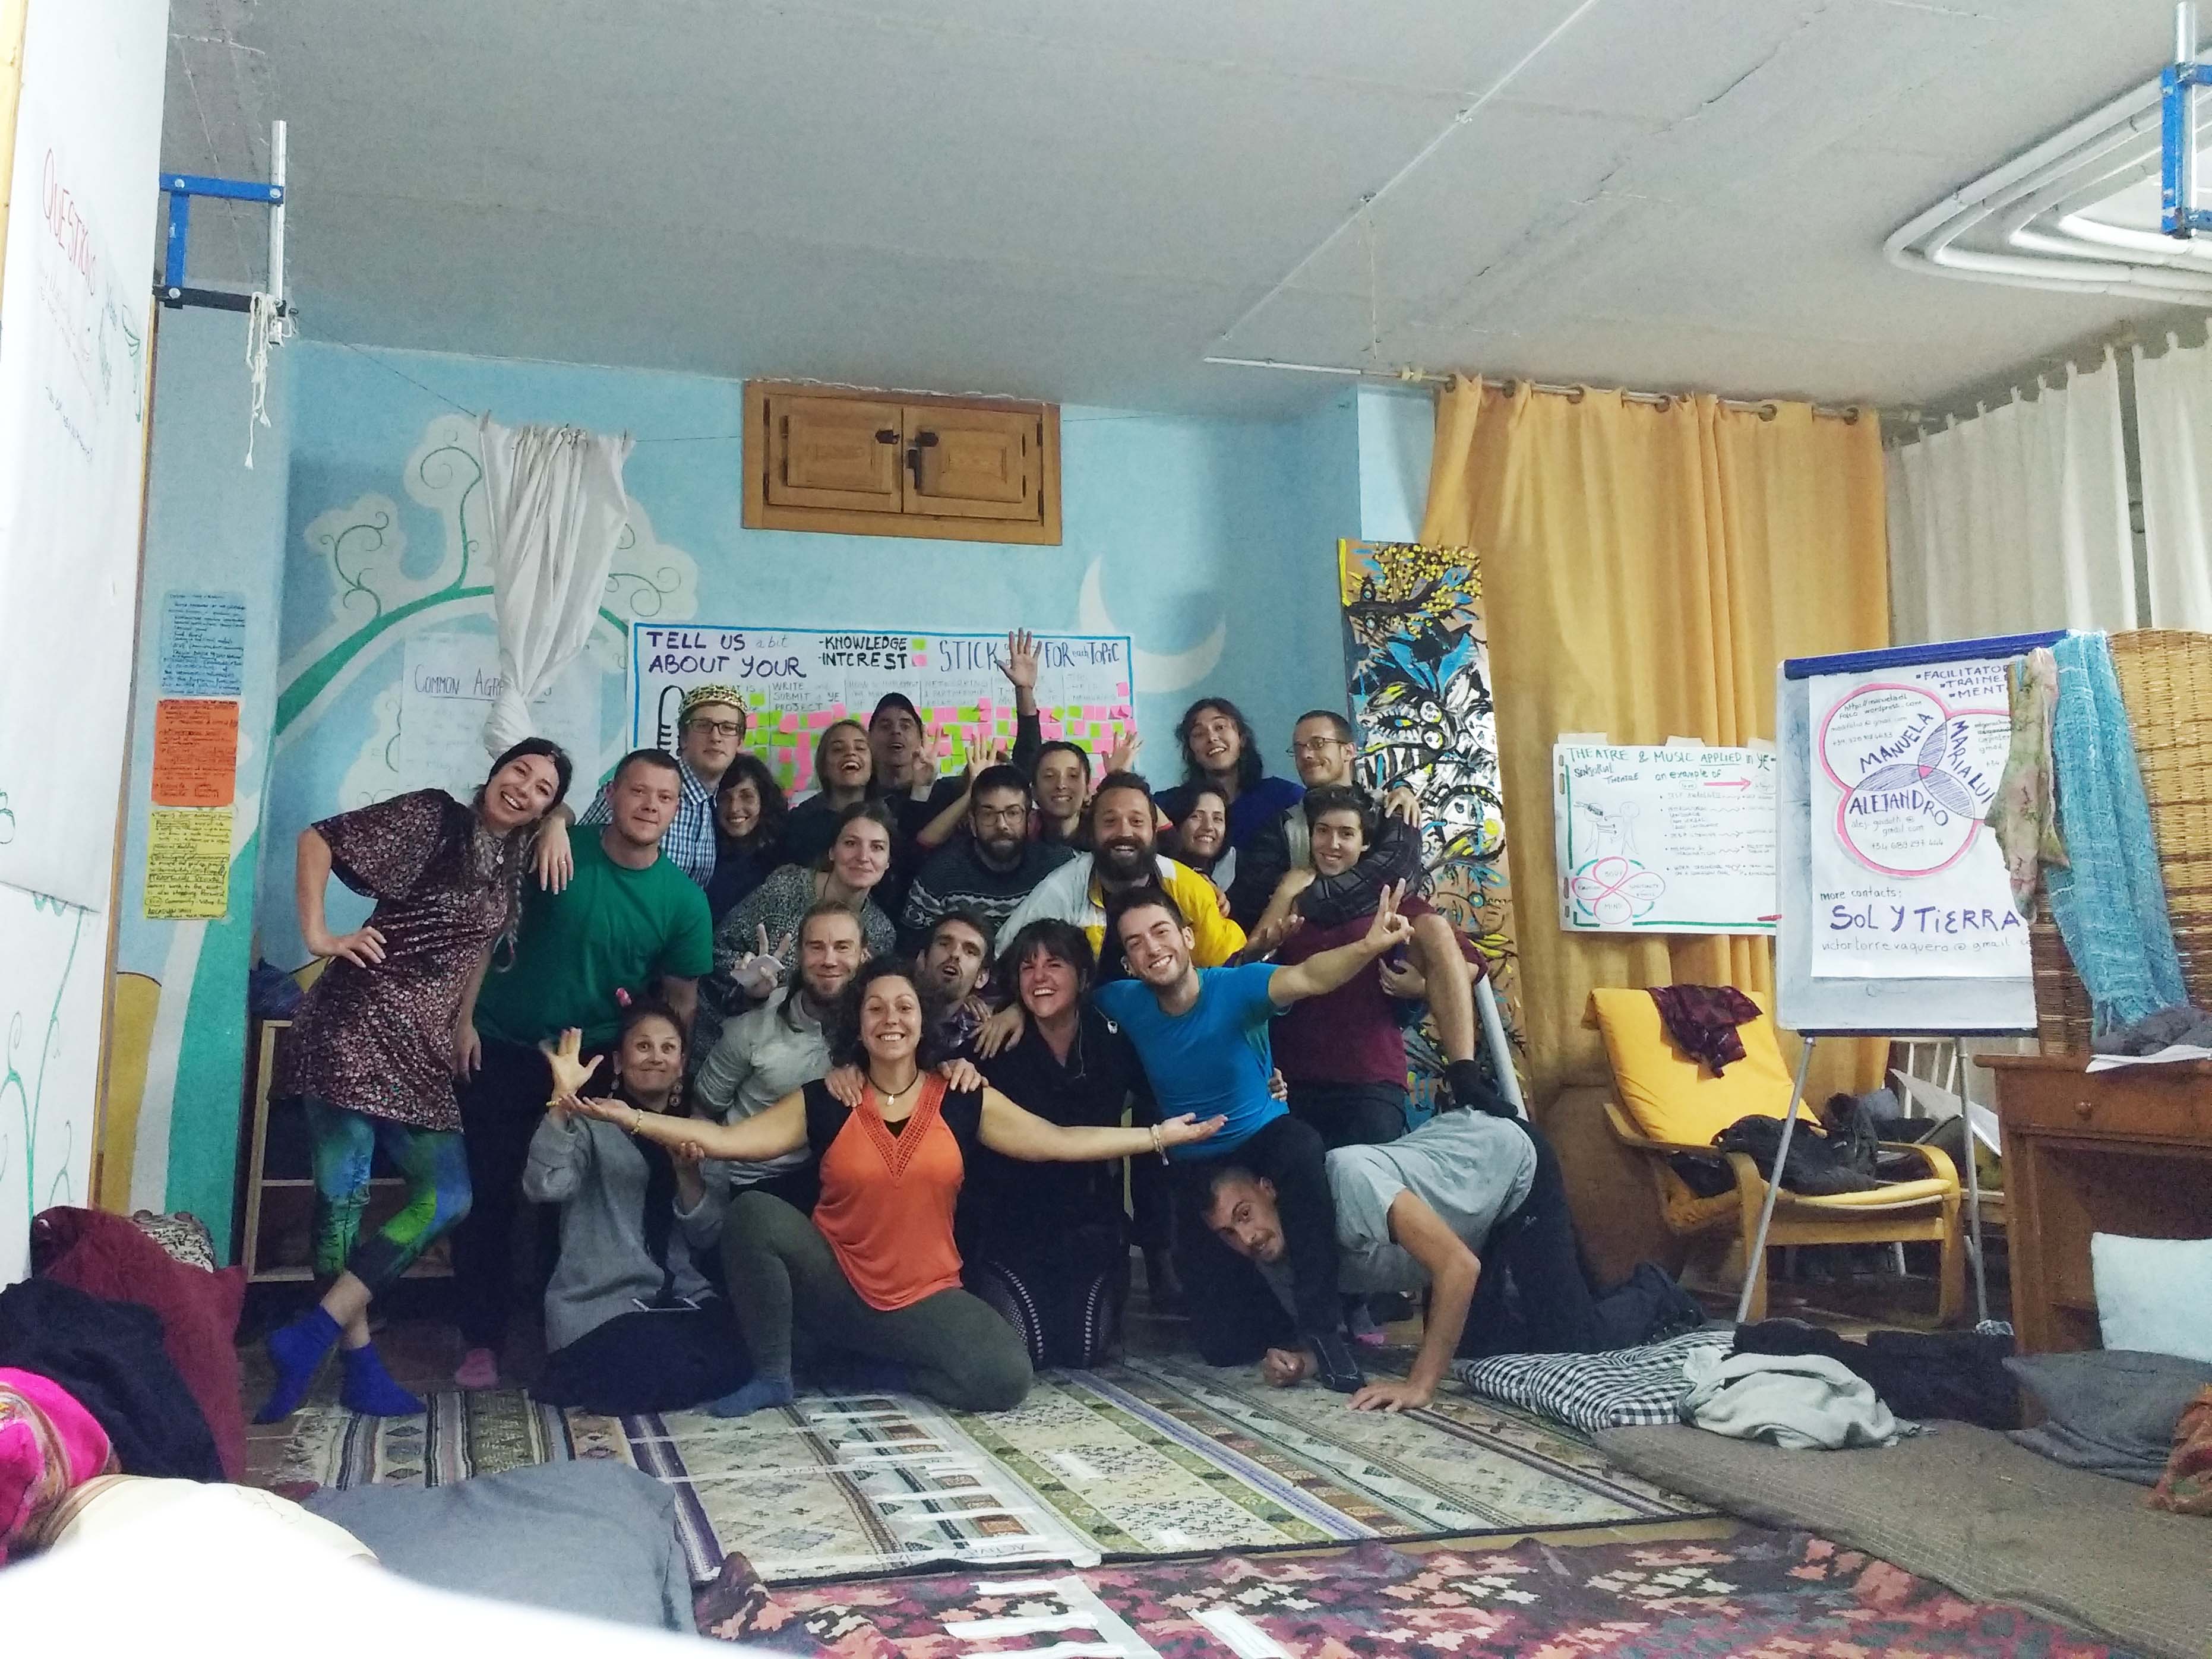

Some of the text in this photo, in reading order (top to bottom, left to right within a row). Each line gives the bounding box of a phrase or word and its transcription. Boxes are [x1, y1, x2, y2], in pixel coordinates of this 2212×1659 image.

[646, 631, 707, 649] TELL
[721, 633, 745, 651] US
[940, 640, 999, 672] STICK
[1045, 642, 1075, 668] FOR
[648, 654, 807, 678] ABOUT YOUR
[772, 682, 803, 691] WRITE
[1958, 684, 2005, 699] MENT
[773, 692, 810, 701] SUBMIT
[775, 703, 823, 712] PROJECT
[1859, 713, 1934, 773] MANUELA
[1566, 747, 1630, 762] THEATRE
[1638, 750, 1649, 763] &
[1654, 750, 1694, 763] MUSIC
[1701, 751, 1742, 763] APPLIED
[1947, 720, 1996, 804] MARIALUI
[1601, 772, 1639, 785] THEATRE
[1655, 772, 1667, 781] an
[1669, 767, 1708, 779] example
[1820, 891, 1846, 901] more
